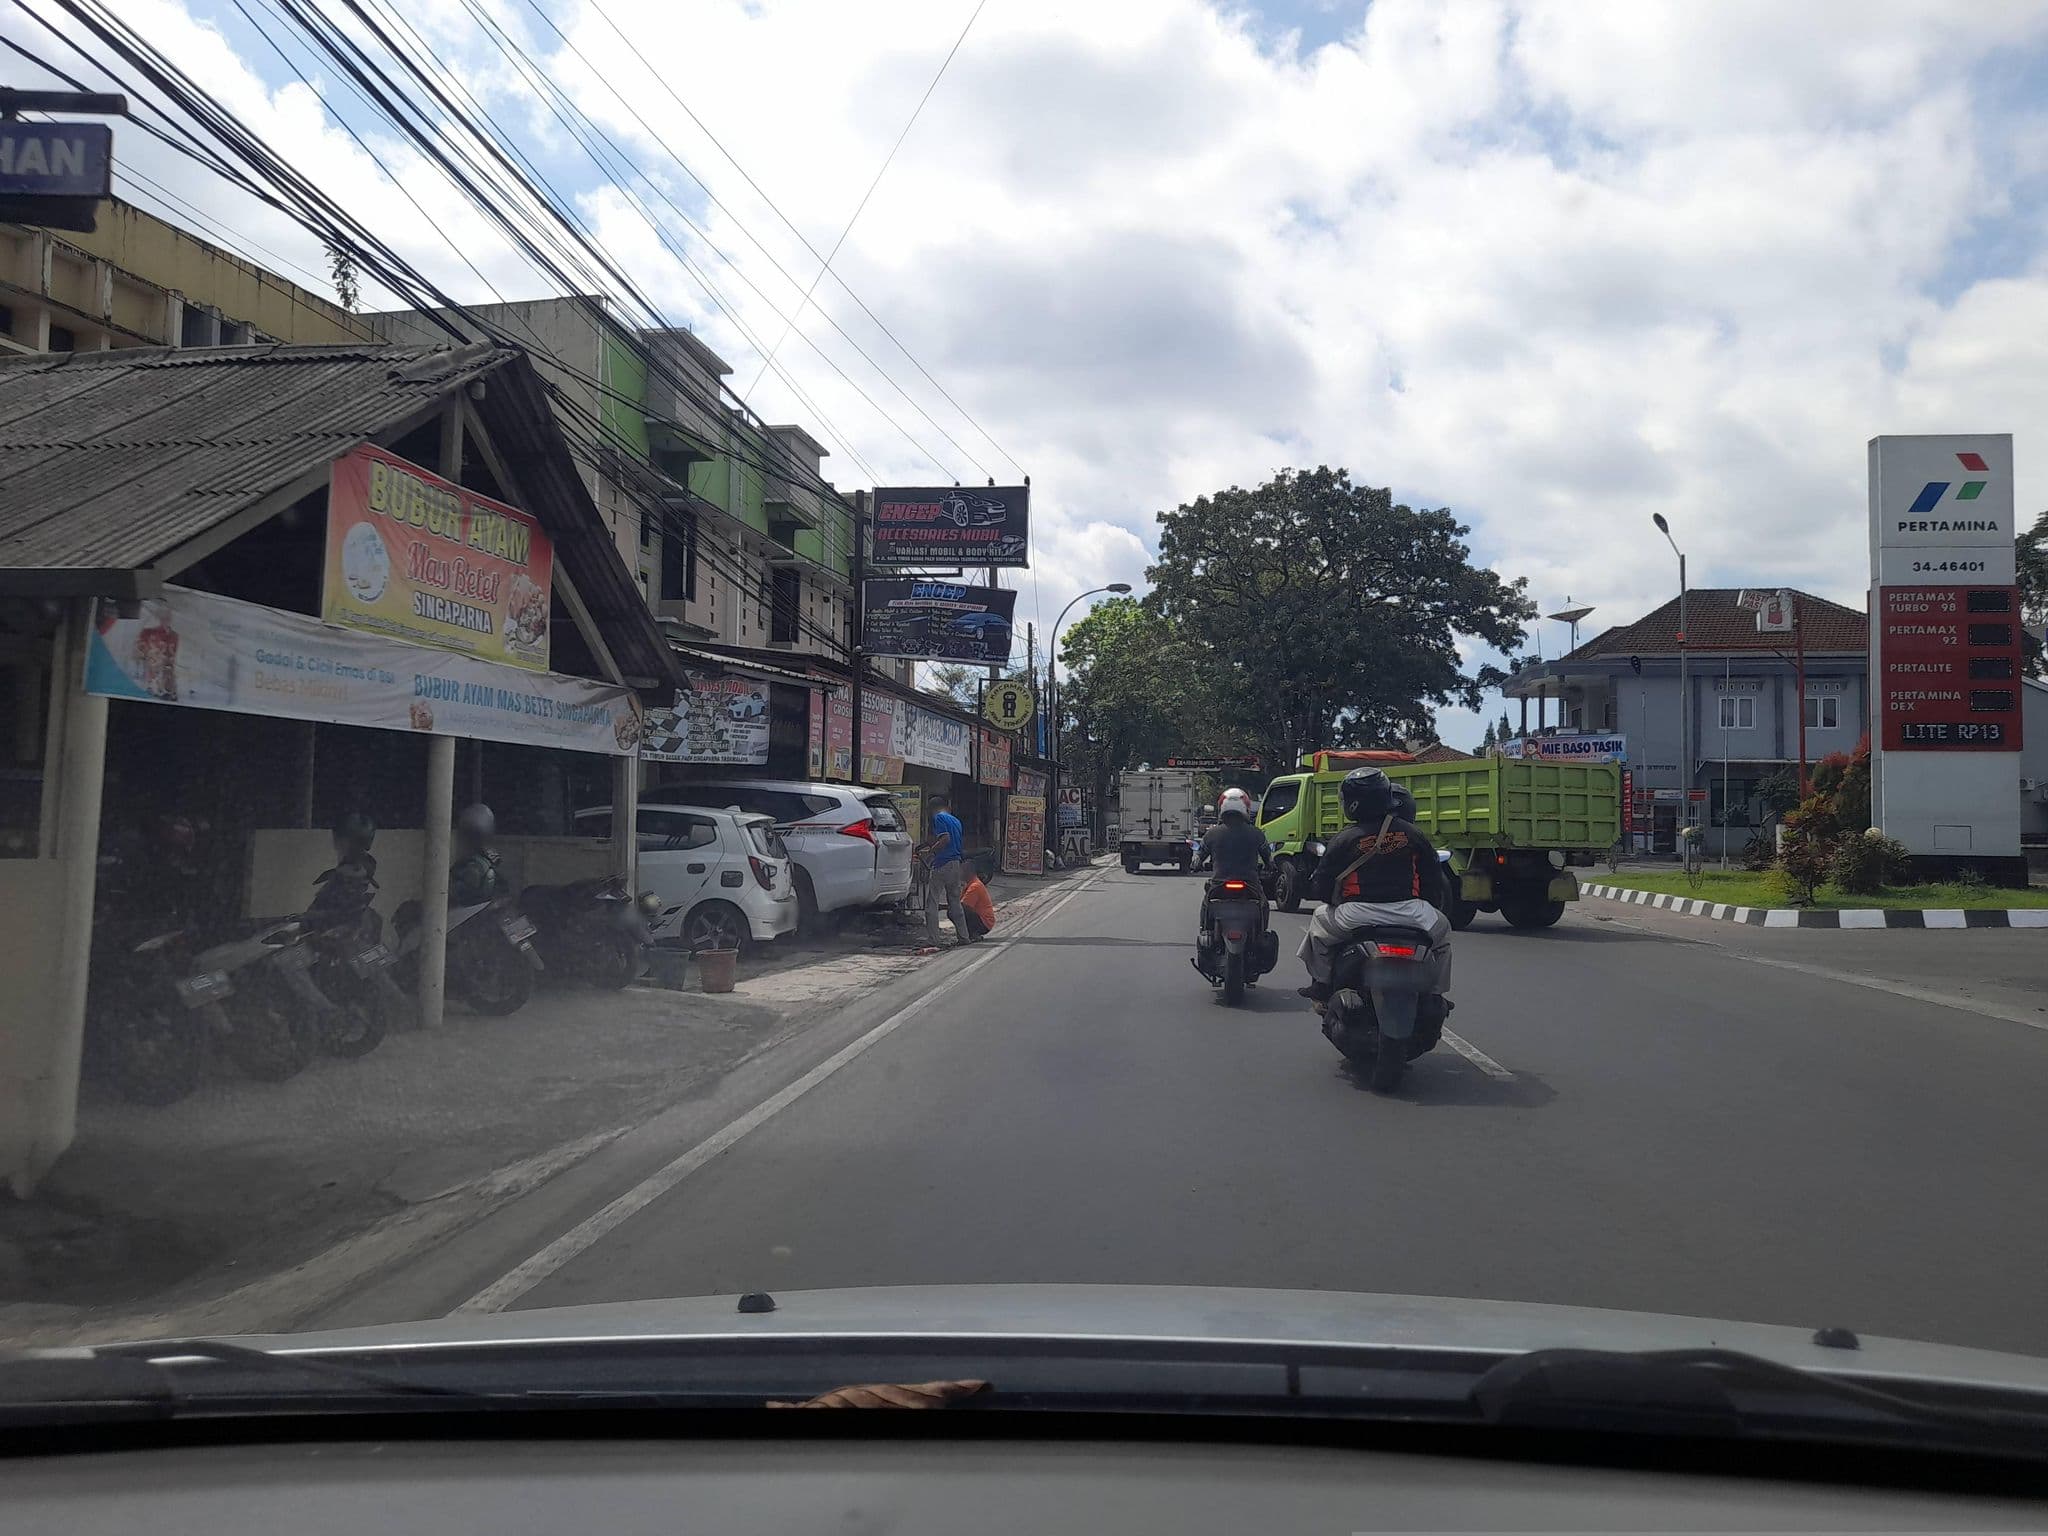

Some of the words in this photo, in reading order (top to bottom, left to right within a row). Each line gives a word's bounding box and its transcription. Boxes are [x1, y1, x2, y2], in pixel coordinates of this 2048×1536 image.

[368, 458, 463, 544] BUBUR
[467, 504, 530, 568] AYAM
[878, 502, 944, 522] ENCEP
[1898, 520, 1998, 532] PERTAMINA
[960, 529, 1000, 542] MOBIL
[896, 547, 928, 556] VARIASI
[930, 547, 956, 556] MOBIL
[966, 547, 988, 556] BODY
[911, 583, 967, 600] ENCEP
[1889, 592, 1957, 602] PERTAMAX
[413, 591, 493, 635] SINGAPARNA
[1890, 603, 1930, 612] TURBO
[1941, 603, 1957, 612] 98
[1889, 625, 1957, 634] PERTAMAX
[1942, 636, 1958, 646] 92
[1890, 664, 1953, 673] PERTALITE
[414, 674, 460, 702] BUBUR
[463, 683, 494, 708] AYAM
[497, 688, 521, 713] MAS
[1890, 691, 1961, 701] PERTAMINA
[1890, 702, 1915, 711] DEX
[1958, 724, 2001, 739] RP13
[1541, 742, 1561, 755] MIE
[1562, 741, 1591, 754] BASO
[1592, 740, 1623, 753] TASIK
[1060, 789, 1080, 804] AC
[1064, 836, 1089, 857] AC
